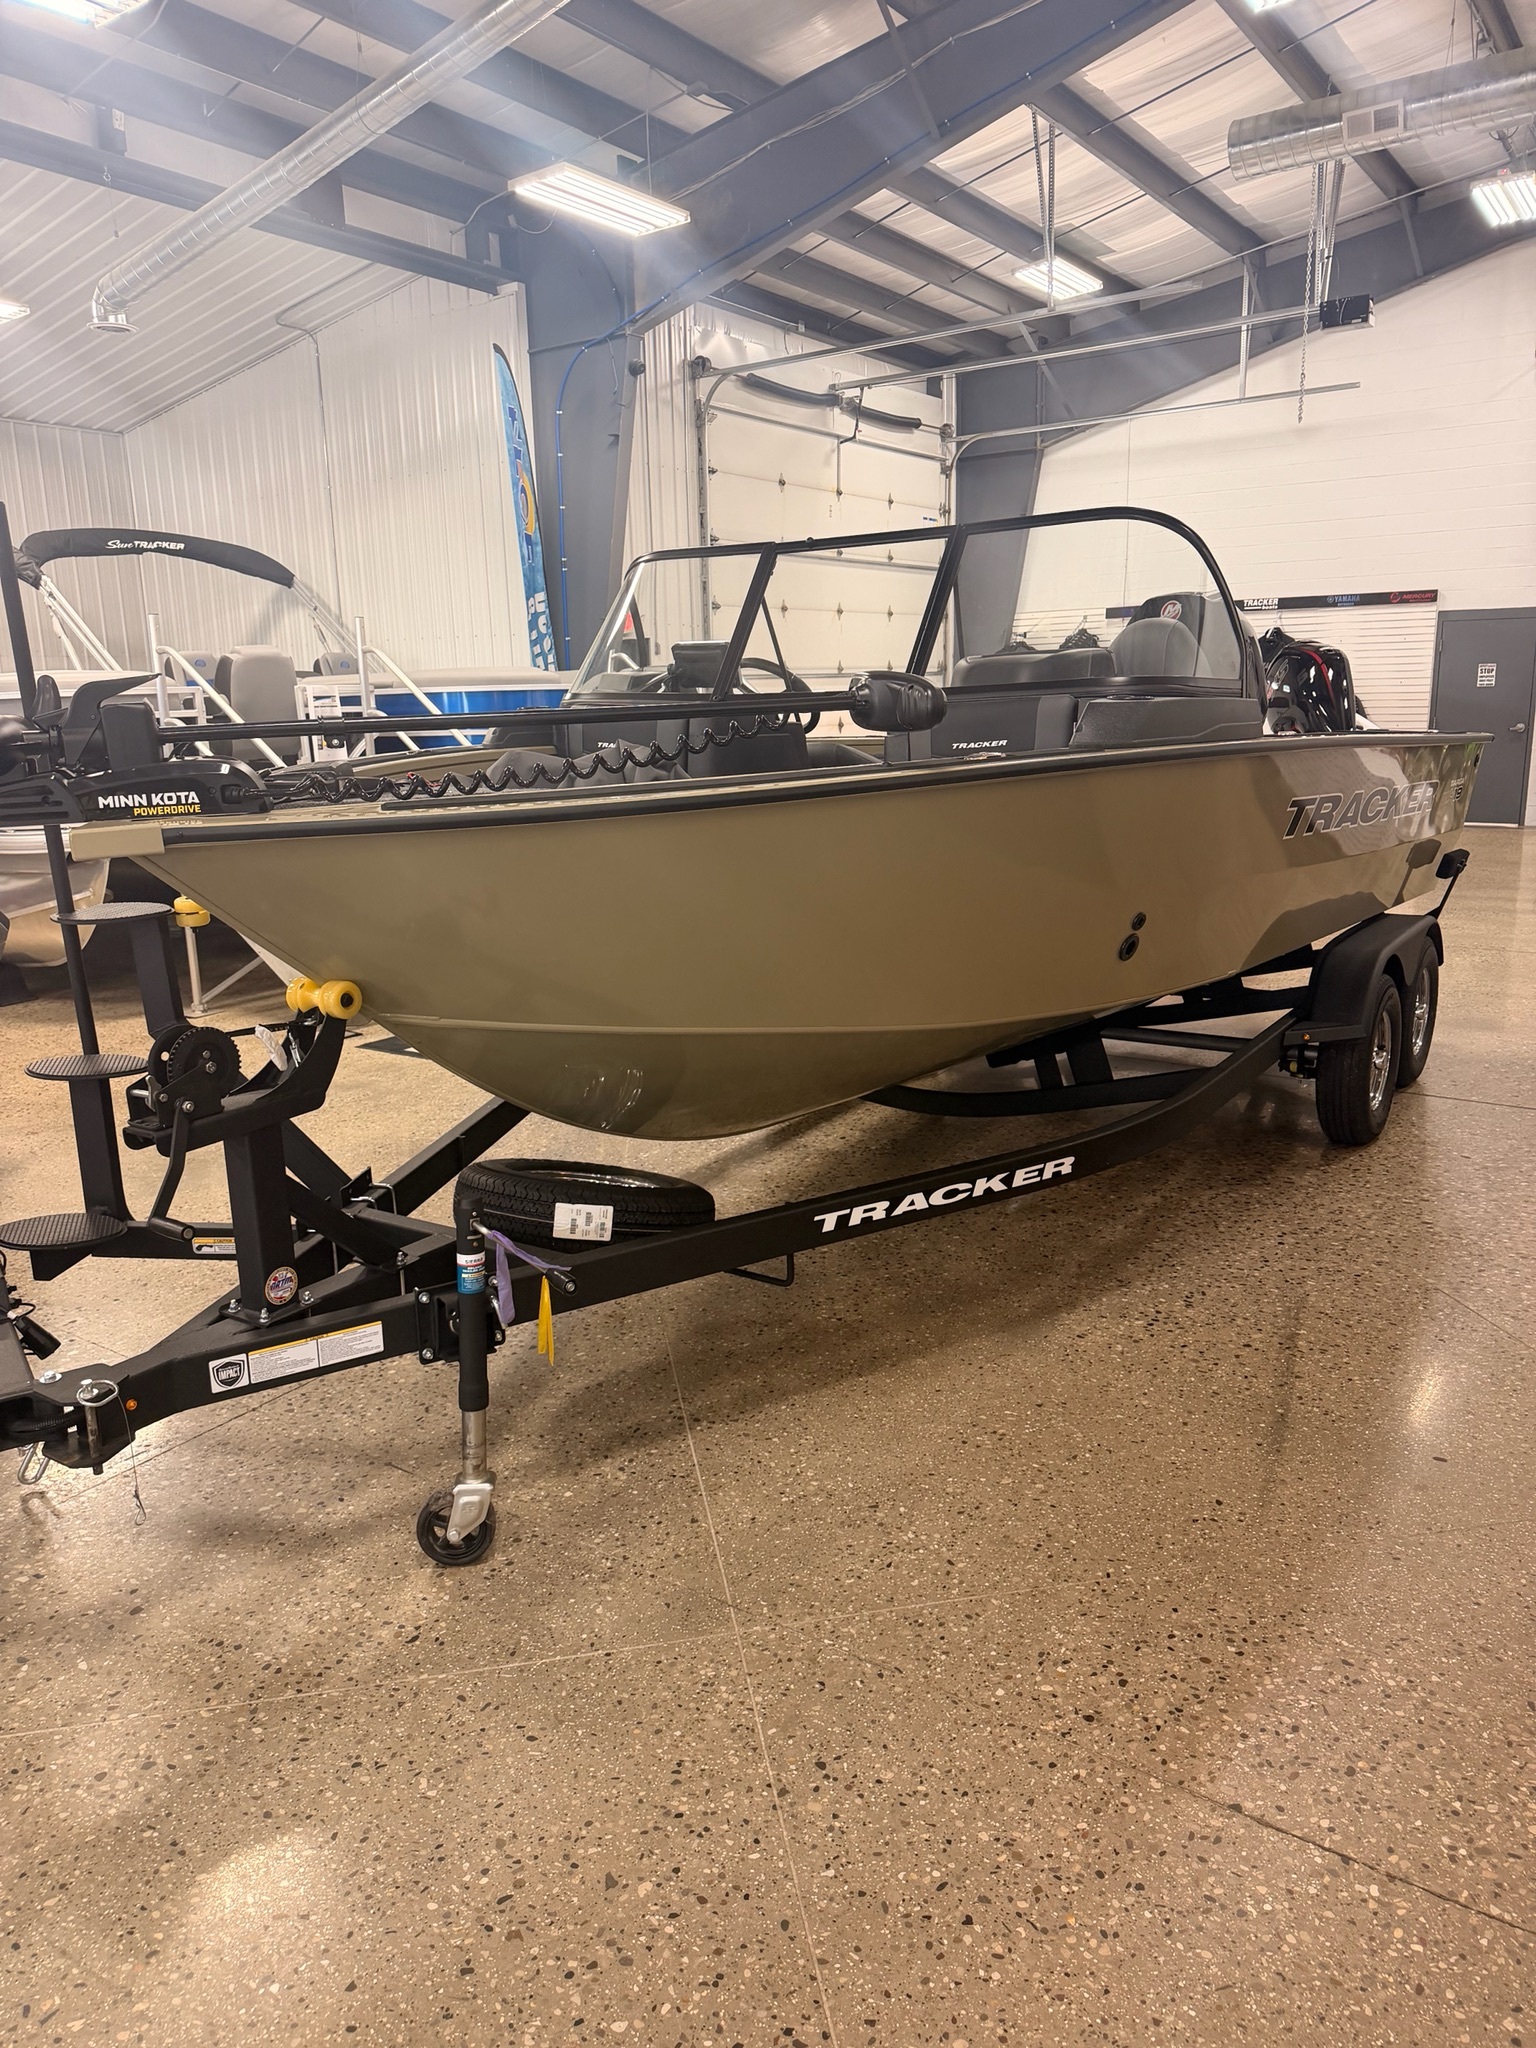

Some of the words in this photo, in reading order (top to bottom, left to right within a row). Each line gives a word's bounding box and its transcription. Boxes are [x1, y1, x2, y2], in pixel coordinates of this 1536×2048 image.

[1243, 598, 1279, 606] TRACKER
[1334, 595, 1360, 603] YAMAHA
[952, 740, 1008, 750] TRACKER
[98, 794, 148, 809] MINN
[151, 791, 200, 806] KOTA
[133, 804, 202, 817] POWERDRIVE
[1283, 780, 1440, 840] TRACKER
[813, 1156, 1076, 1233] TRACKER
